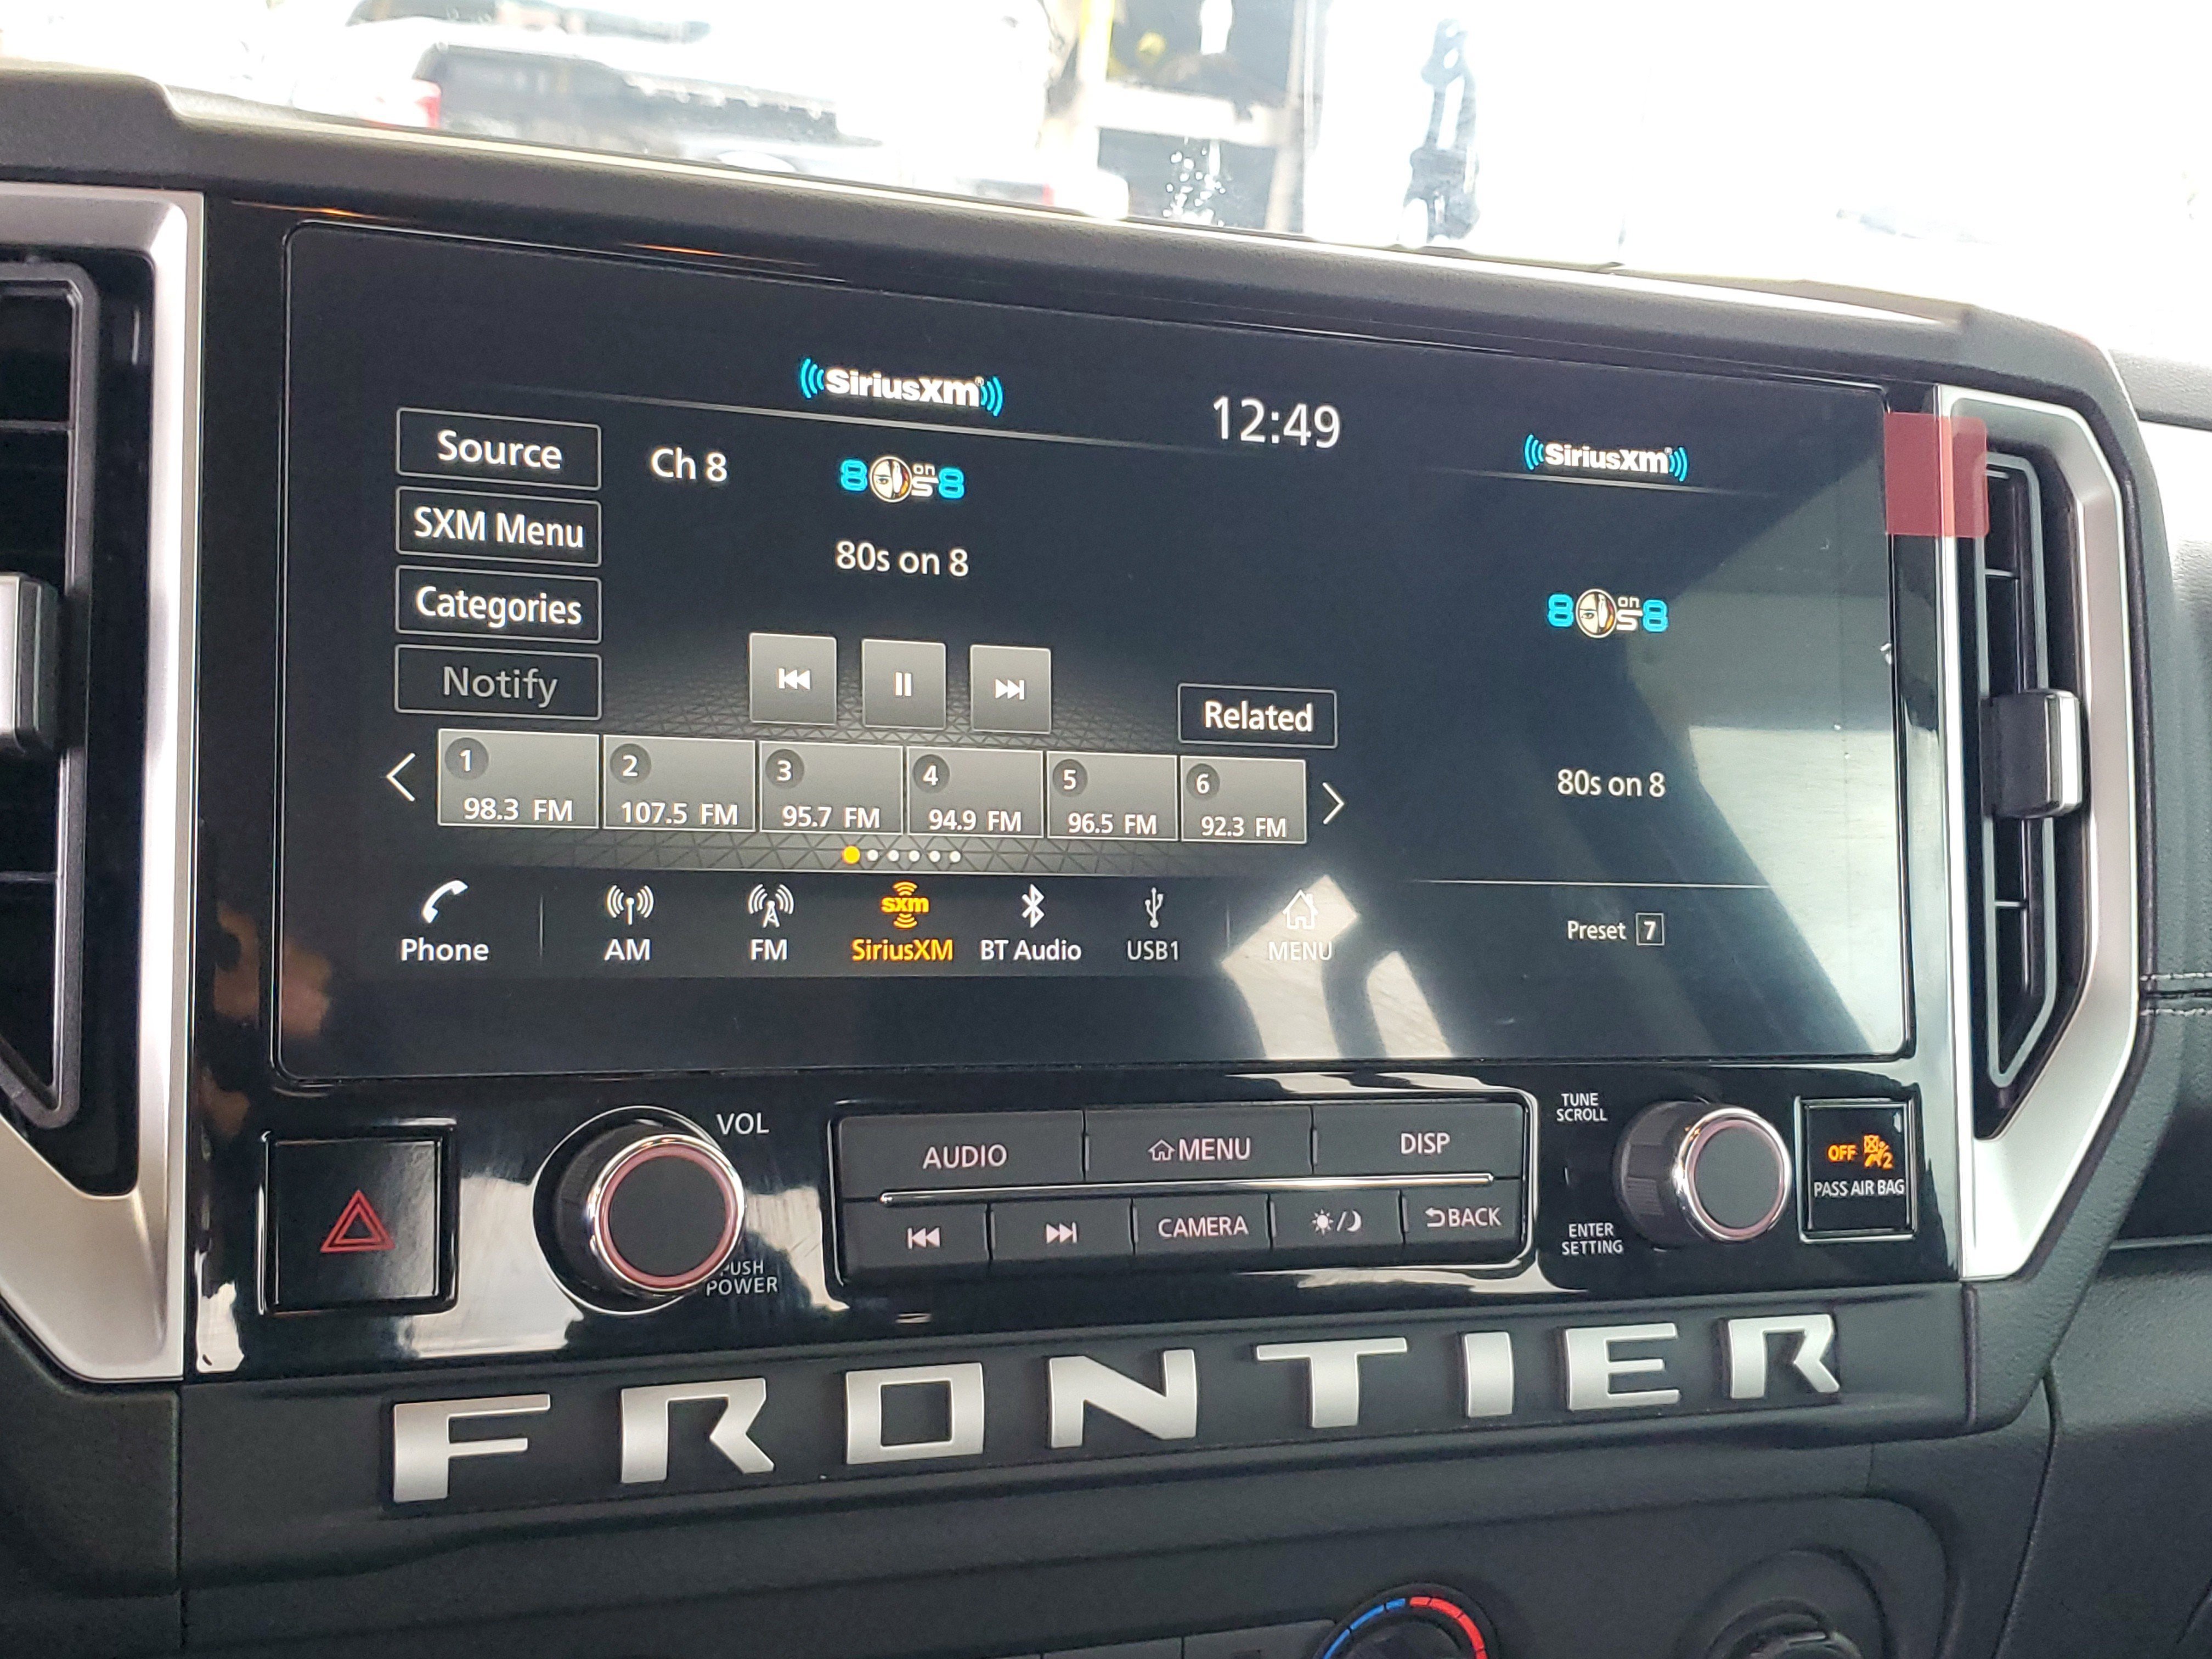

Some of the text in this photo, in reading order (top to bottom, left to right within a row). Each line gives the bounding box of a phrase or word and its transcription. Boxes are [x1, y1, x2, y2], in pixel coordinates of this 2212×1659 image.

[1212, 396, 1341, 448] 12:49
[437, 430, 562, 470] Source
[651, 448, 727, 483] Ch 8
[939, 467, 965, 499] 8
[414, 506, 584, 548] SXM Menu
[836, 540, 969, 577] 80s on 8
[416, 586, 583, 628] Categories
[1643, 600, 1669, 632] 8
[443, 666, 558, 708] Notify
[1203, 701, 1313, 732] Related
[459, 749, 473, 772] 1
[622, 755, 639, 777] 2
[777, 760, 792, 782] 3
[923, 765, 939, 786] 4
[1063, 769, 1077, 790] 5
[1196, 774, 1209, 794] 6
[1557, 769, 1666, 798] 80s on 8
[463, 798, 573, 822] 98.3 FM
[621, 801, 739, 826] 107.5 FM
[782, 806, 881, 829] 95.7 FM
[928, 809, 1022, 832] 94.9 FM
[1068, 812, 1158, 835] 96.5 FM
[1201, 816, 1287, 838] 92.3 FM
[1567, 920, 1657, 940] Preset 7
[400, 938, 489, 961] Phone
[604, 939, 651, 961] AM
[751, 939, 788, 961] FM
[851, 939, 953, 962] SiriusXM
[980, 939, 1082, 962] BT Audio
[1127, 941, 1180, 962] USB1
[1268, 941, 1333, 962] MENU
[1561, 1093, 1599, 1107] TUNE
[716, 1113, 770, 1135] VOL
[1556, 1107, 1607, 1122] SCROLL
[1178, 1137, 1251, 1161] MENU
[1401, 1132, 1451, 1154] DISP
[1828, 1144, 1858, 1162] OFF
[922, 1144, 1008, 1170] AUDIO
[1814, 1178, 1905, 1198] PASS AIR BAG
[1158, 1215, 1249, 1238] CAMERA
[1448, 1207, 1502, 1227] BACK
[1568, 1222, 1614, 1238] ENTER
[1561, 1239, 1623, 1255] SETTING
[706, 1276, 778, 1296] POWER
[393, 1314, 1841, 1503] FRONTIER
